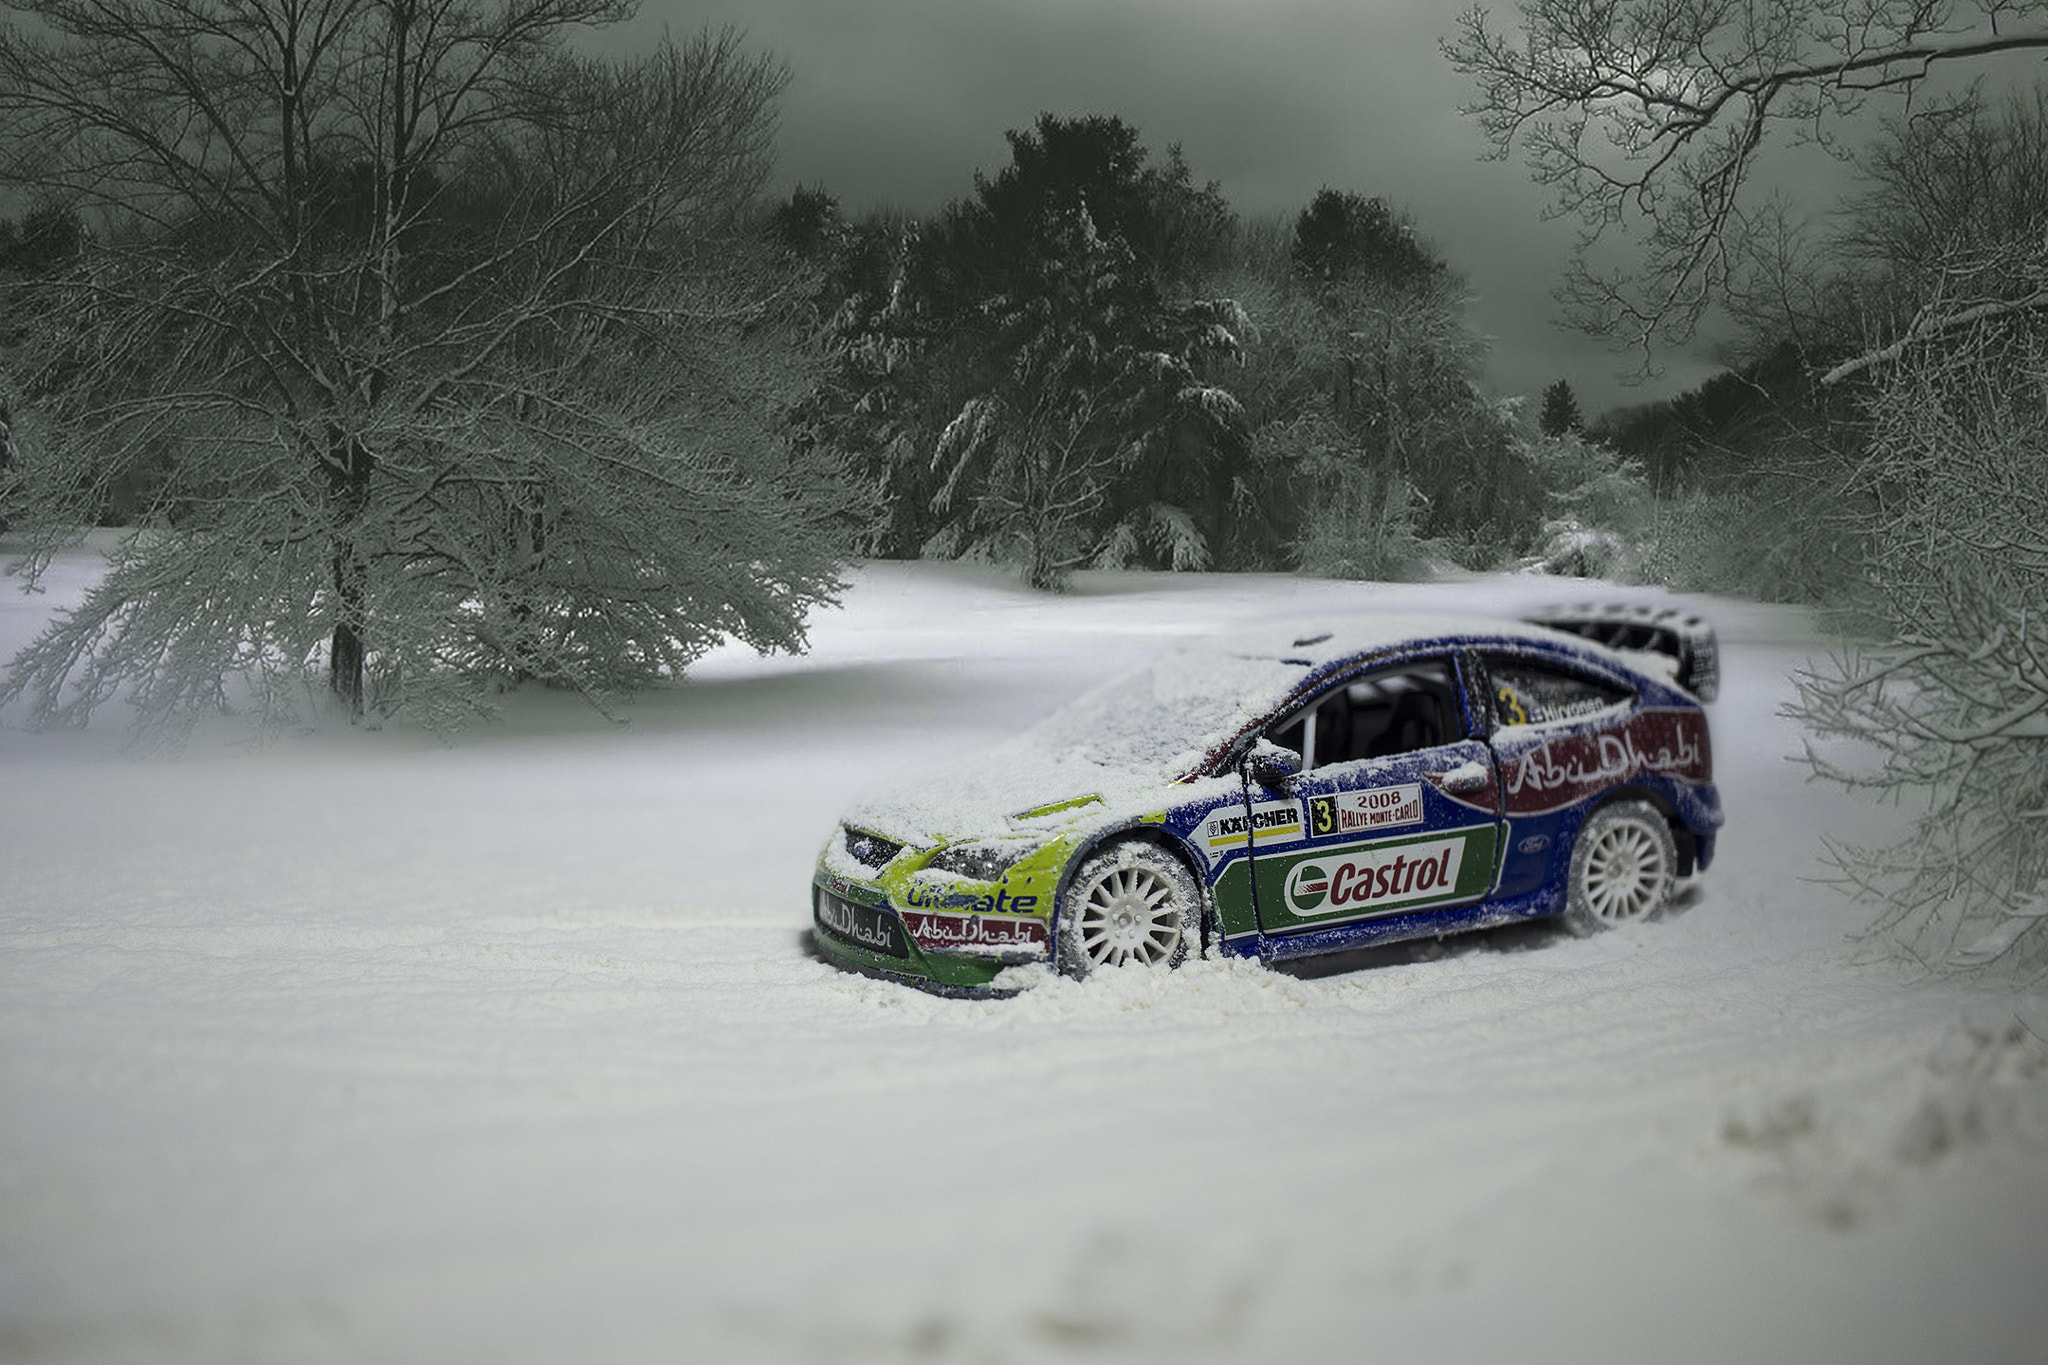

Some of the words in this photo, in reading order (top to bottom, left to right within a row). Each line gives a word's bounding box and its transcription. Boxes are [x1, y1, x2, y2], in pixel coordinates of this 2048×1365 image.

[1500, 688, 1526, 725] 3
[1317, 800, 1332, 832] 3
[1357, 791, 1401, 809] 2008
[1341, 809, 1368, 828] RALLYE
[1330, 848, 1452, 906] Castrol
